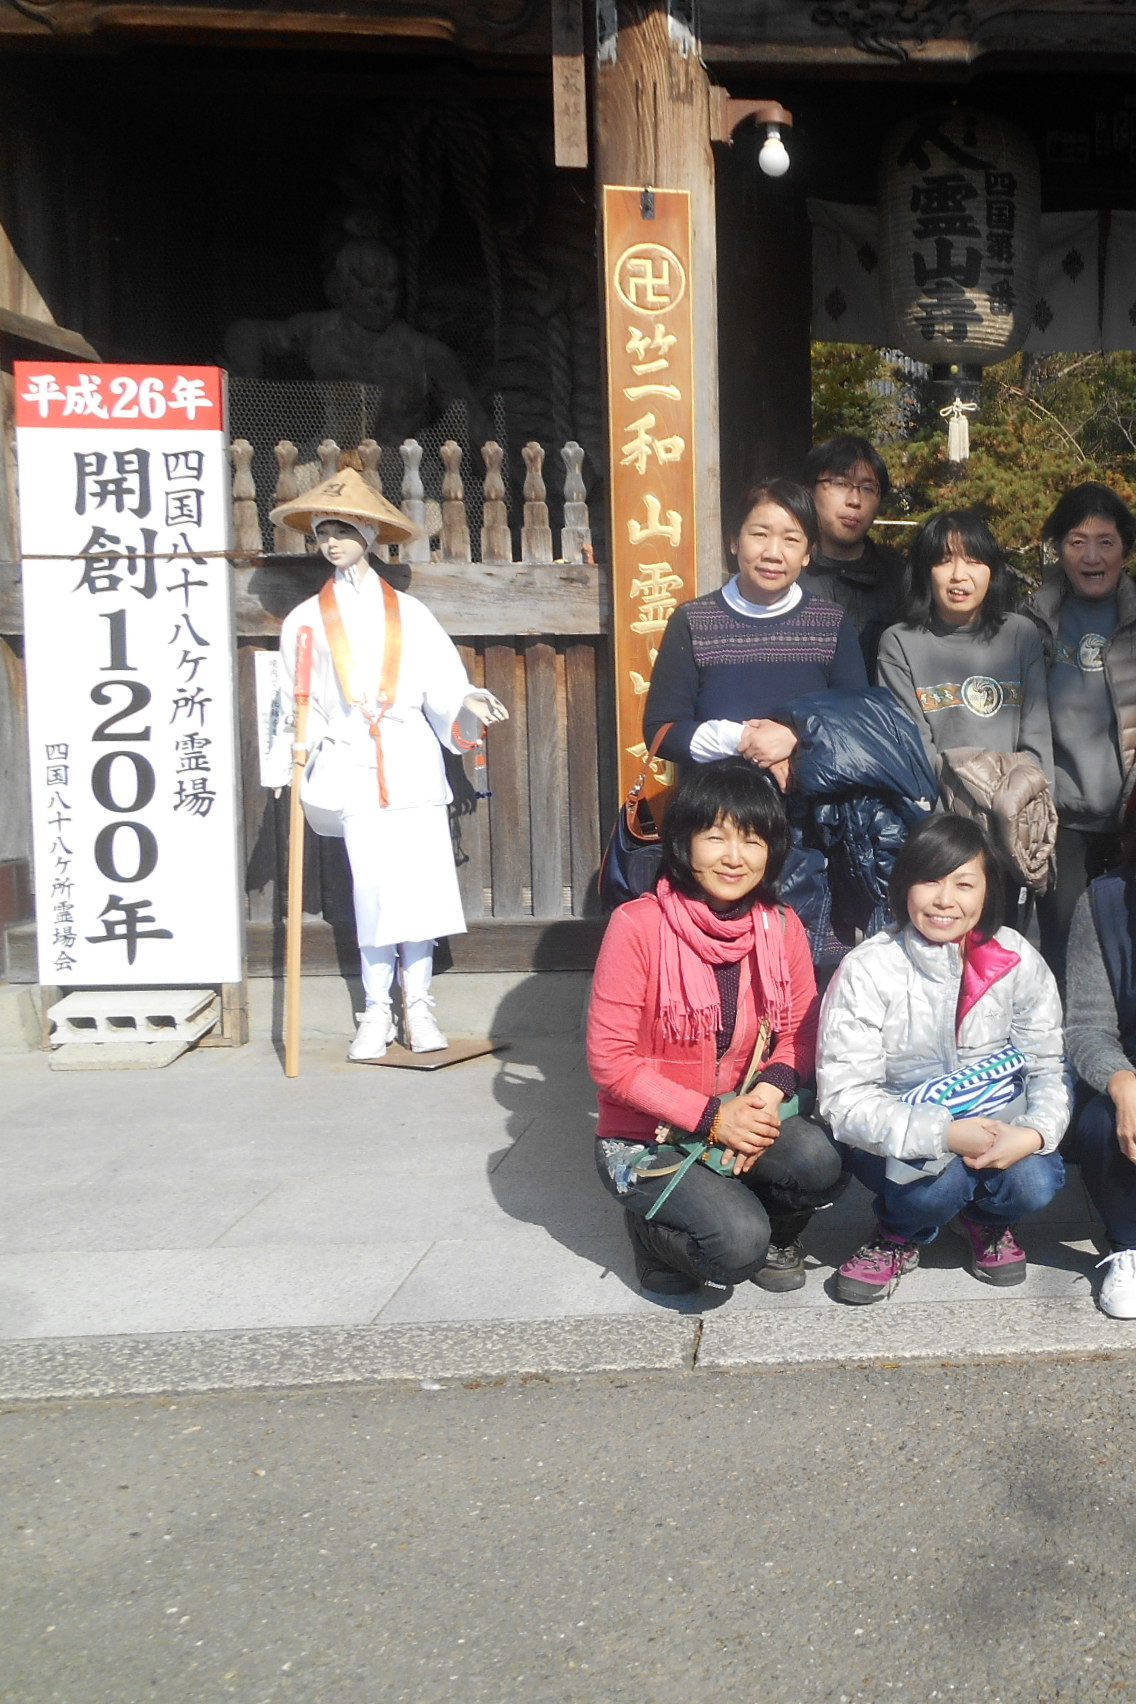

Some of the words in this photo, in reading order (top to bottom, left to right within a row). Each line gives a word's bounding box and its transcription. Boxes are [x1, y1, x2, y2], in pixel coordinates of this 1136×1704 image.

[21, 373, 214, 420] 平成26年
[71, 447, 174, 966] 開創1200年
